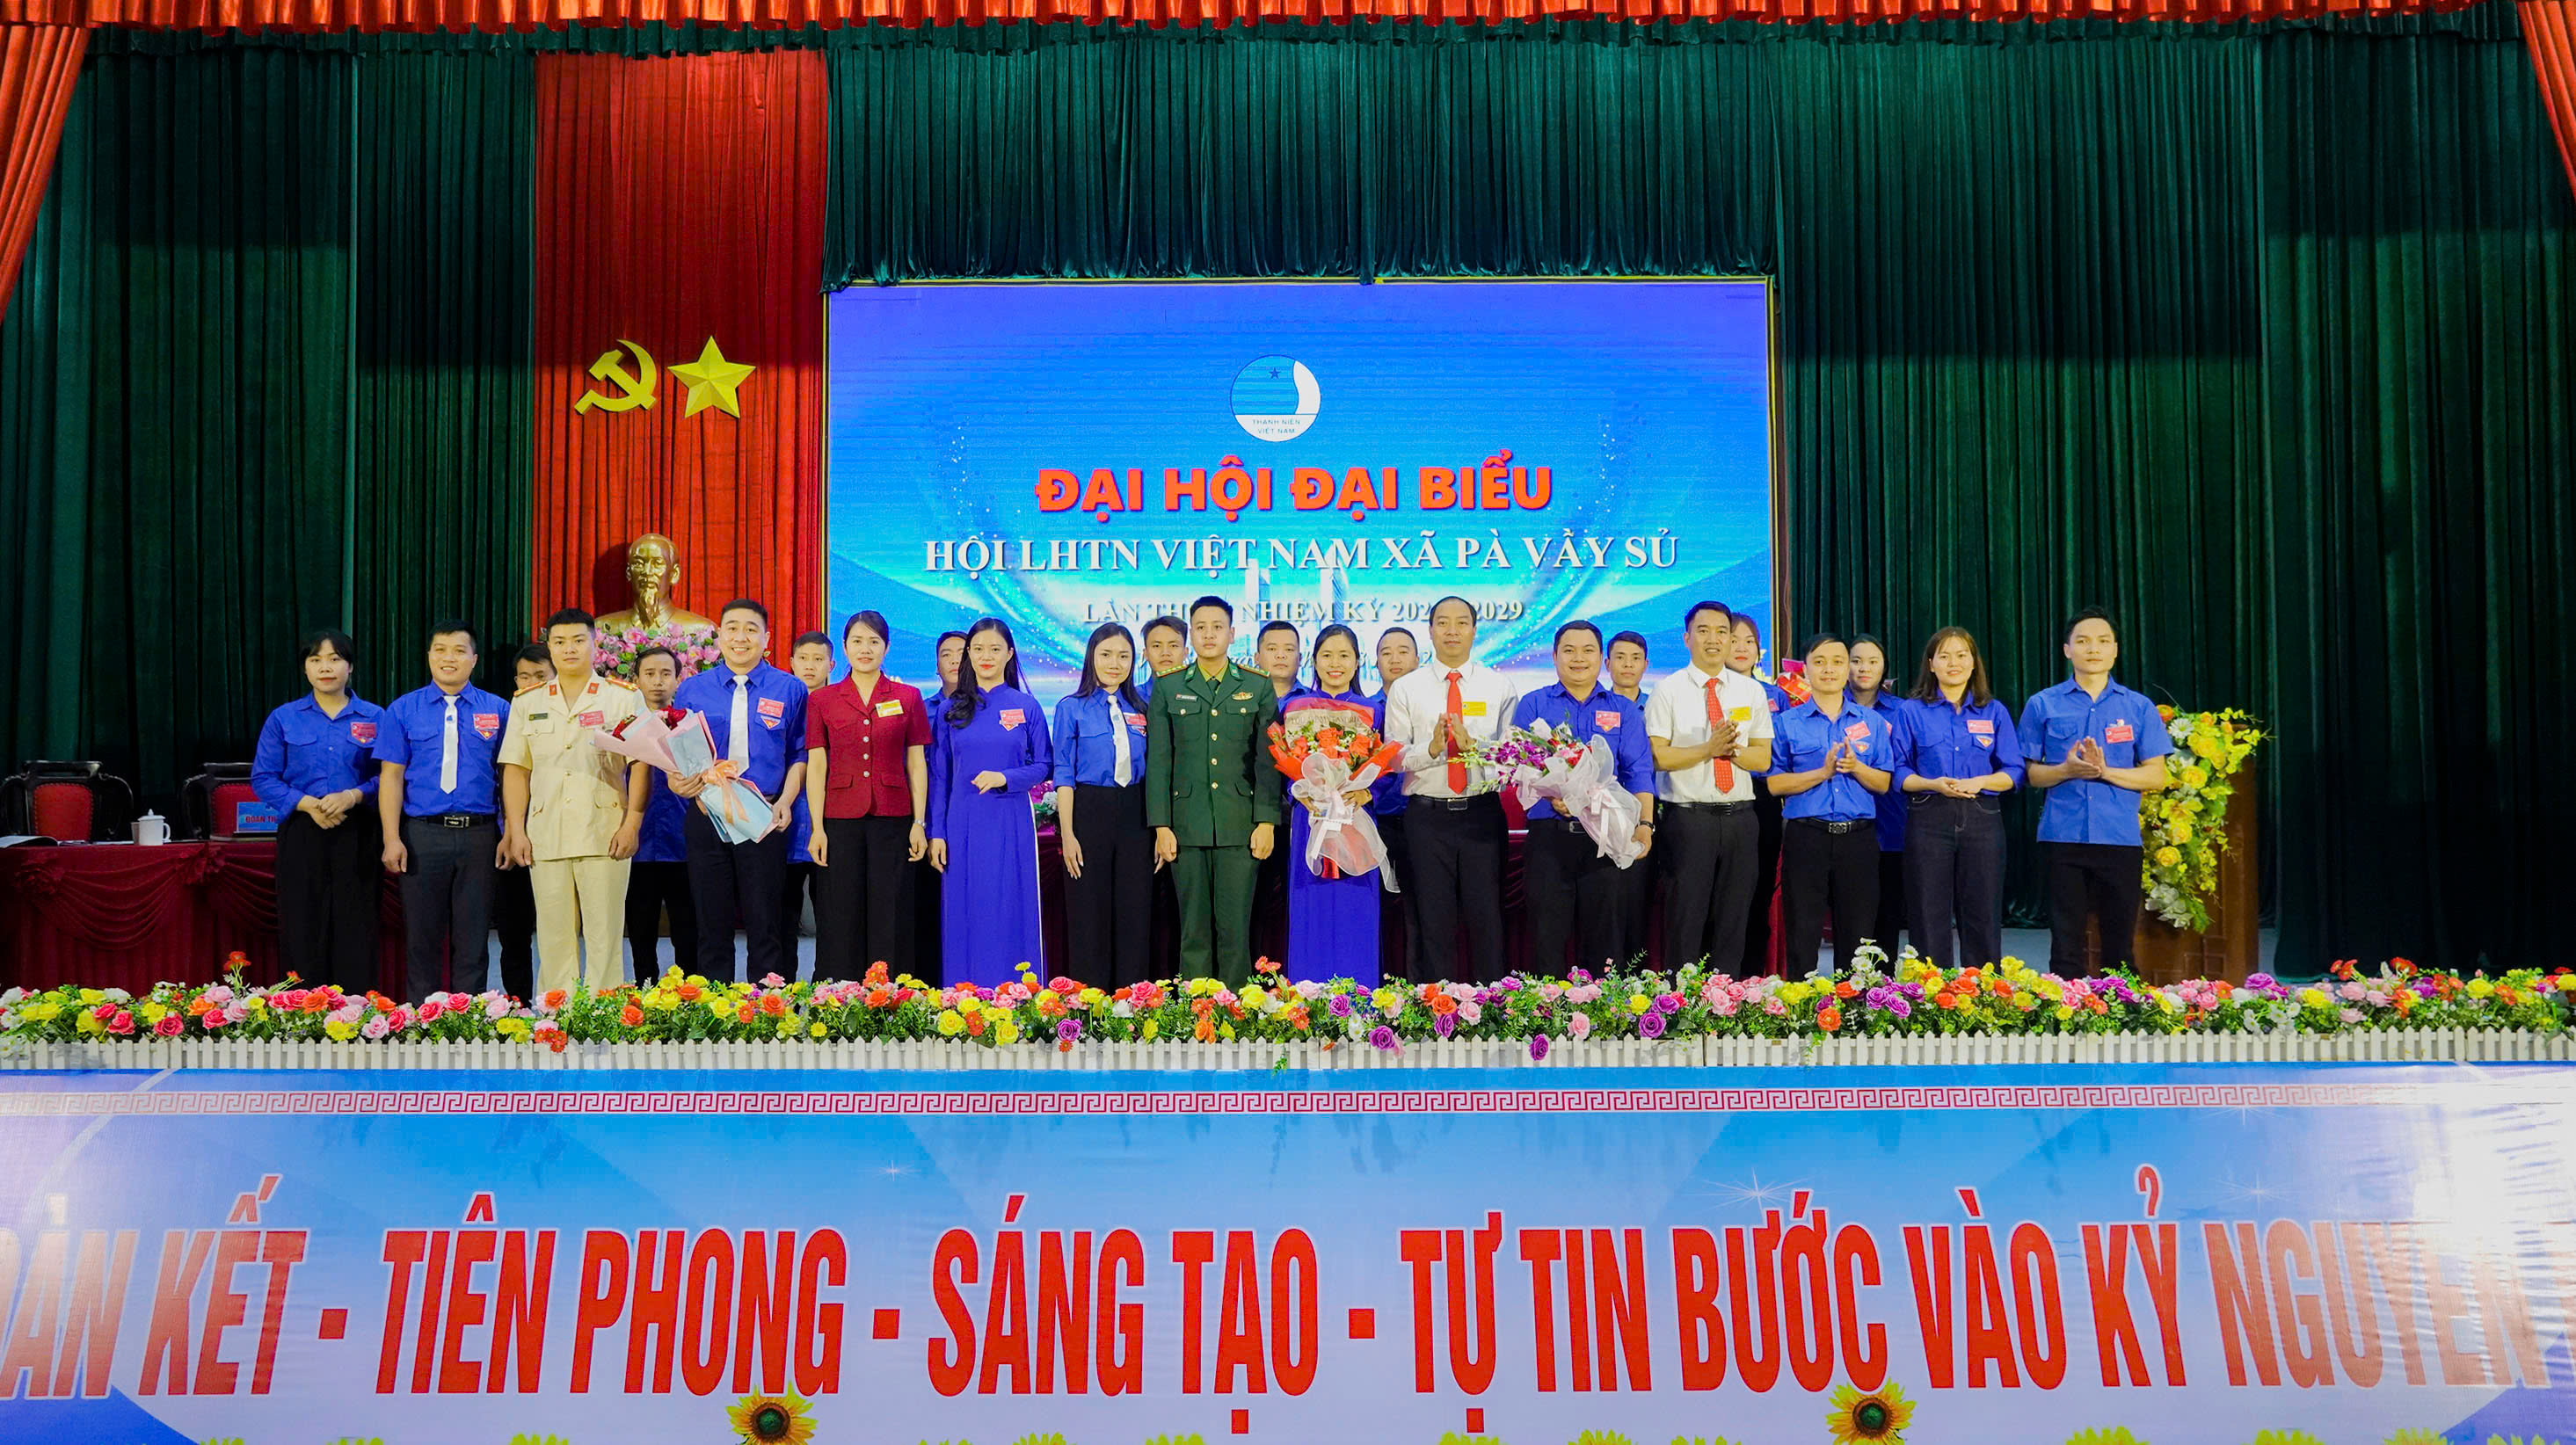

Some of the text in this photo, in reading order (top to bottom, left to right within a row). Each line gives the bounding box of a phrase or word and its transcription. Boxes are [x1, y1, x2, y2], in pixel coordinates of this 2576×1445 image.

[1034, 449, 1553, 523] ĐẠI HỘI ĐẠI BIỂU
[924, 527, 1680, 580] HỘI LHTN VIỆT NAM XÃ PÀ VẦY SỦ
[1083, 598, 1140, 623] LẦN
[1147, 601, 1190, 623] TH
[1242, 599, 1335, 627] NHIỆM
[0, 1194, 138, 1397] ÀN
[138, 1175, 308, 1395] KẾT
[375, 1194, 556, 1394] TIÊN
[570, 1228, 848, 1396] PHONG
[928, 1194, 1145, 1396] SÁNG
[1172, 1228, 1318, 1434] TẠO
[1401, 1211, 1503, 1433] TỰ
[1519, 1228, 1653, 1392] TIN
[1672, 1190, 1888, 1391] BƯỚC
[1903, 1188, 2067, 1390] VÀO
[2082, 1165, 2187, 1388] KỶ
